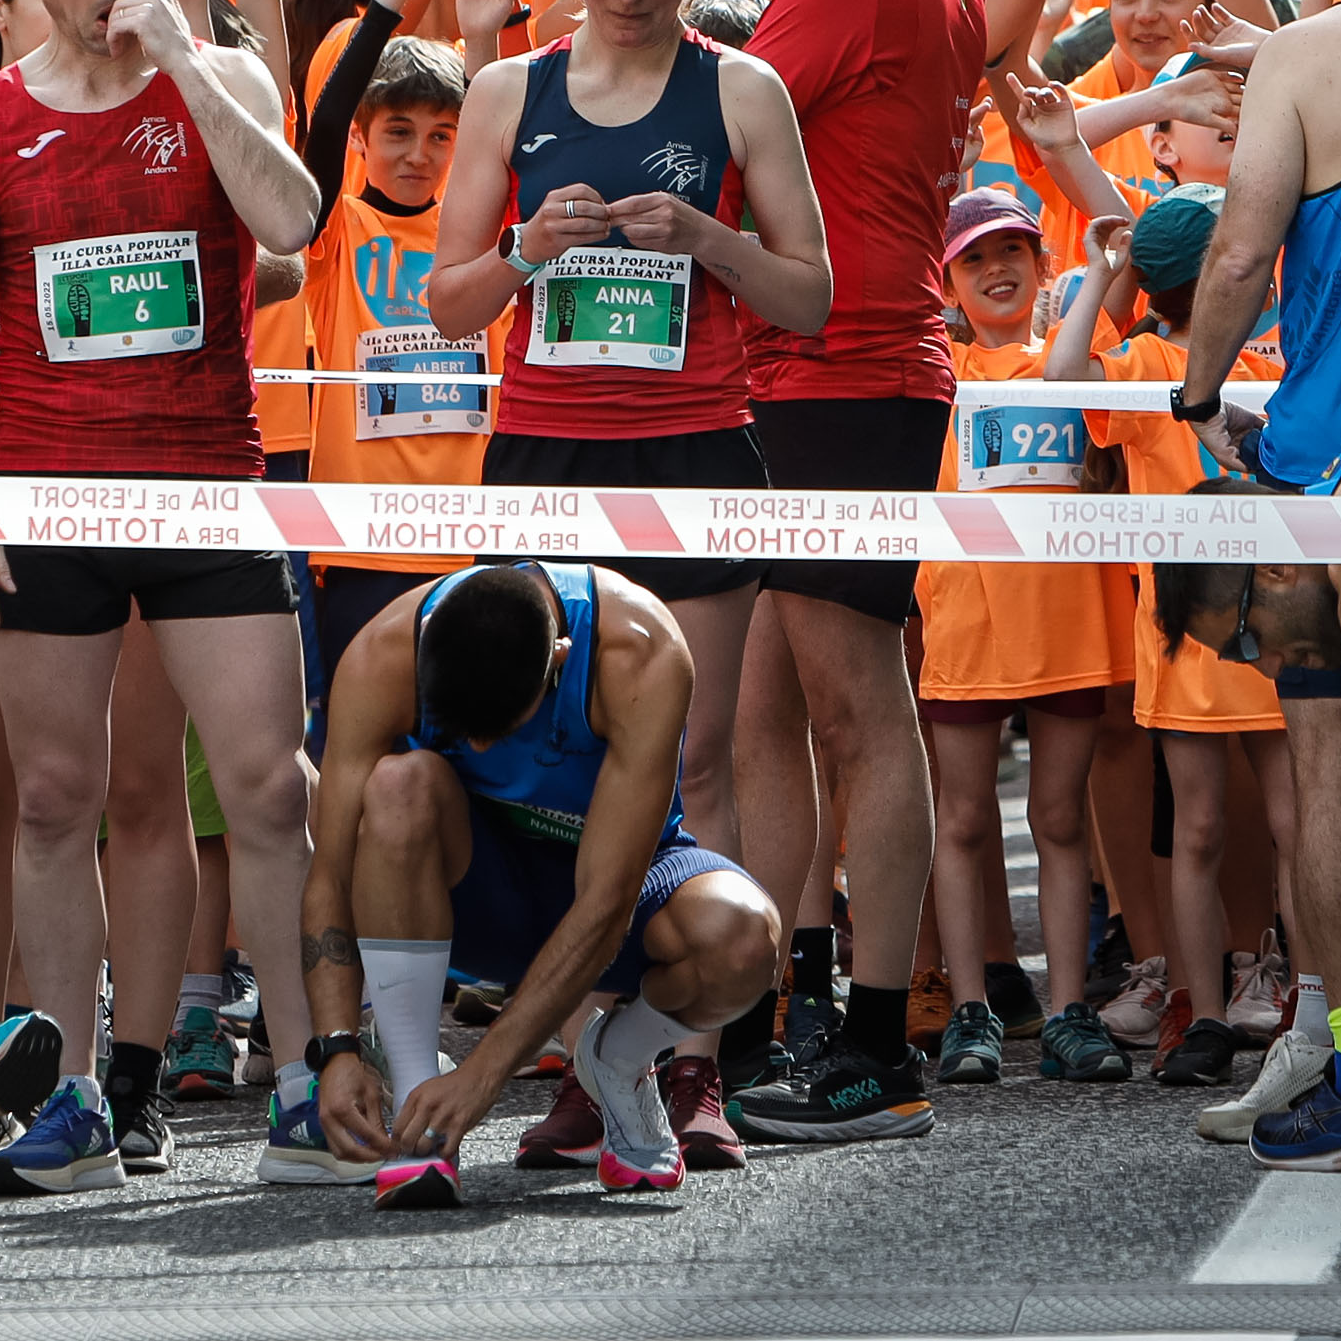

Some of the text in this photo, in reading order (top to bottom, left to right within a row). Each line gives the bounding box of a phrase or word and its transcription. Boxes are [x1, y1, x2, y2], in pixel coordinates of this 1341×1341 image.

[76, 243, 122, 258] CURSA
[128, 238, 190, 251] POPULAR
[62, 249, 182, 271] ILLA CARLEMANY
[570, 256, 615, 266] CURSA
[620, 257, 685, 271] POPULAR
[111, 272, 168, 294] RAUL
[555, 267, 675, 280] ILLA CARLEMANY
[186, 284, 198, 302] 5K
[595, 286, 655, 306] ANNA
[43, 282, 54, 331] 15.05.2022
[135, 300, 150, 323] 6
[537, 286, 545, 334] 15.05.2022
[671, 306, 683, 326] 5K
[609, 313, 636, 335] 21
[385, 332, 426, 343] CURSA
[373, 342, 476, 355] ILLA CARLEMANY
[413, 362, 465, 372] ALBERT
[421, 384, 461, 404] 846
[1012, 423, 1074, 458] 921
